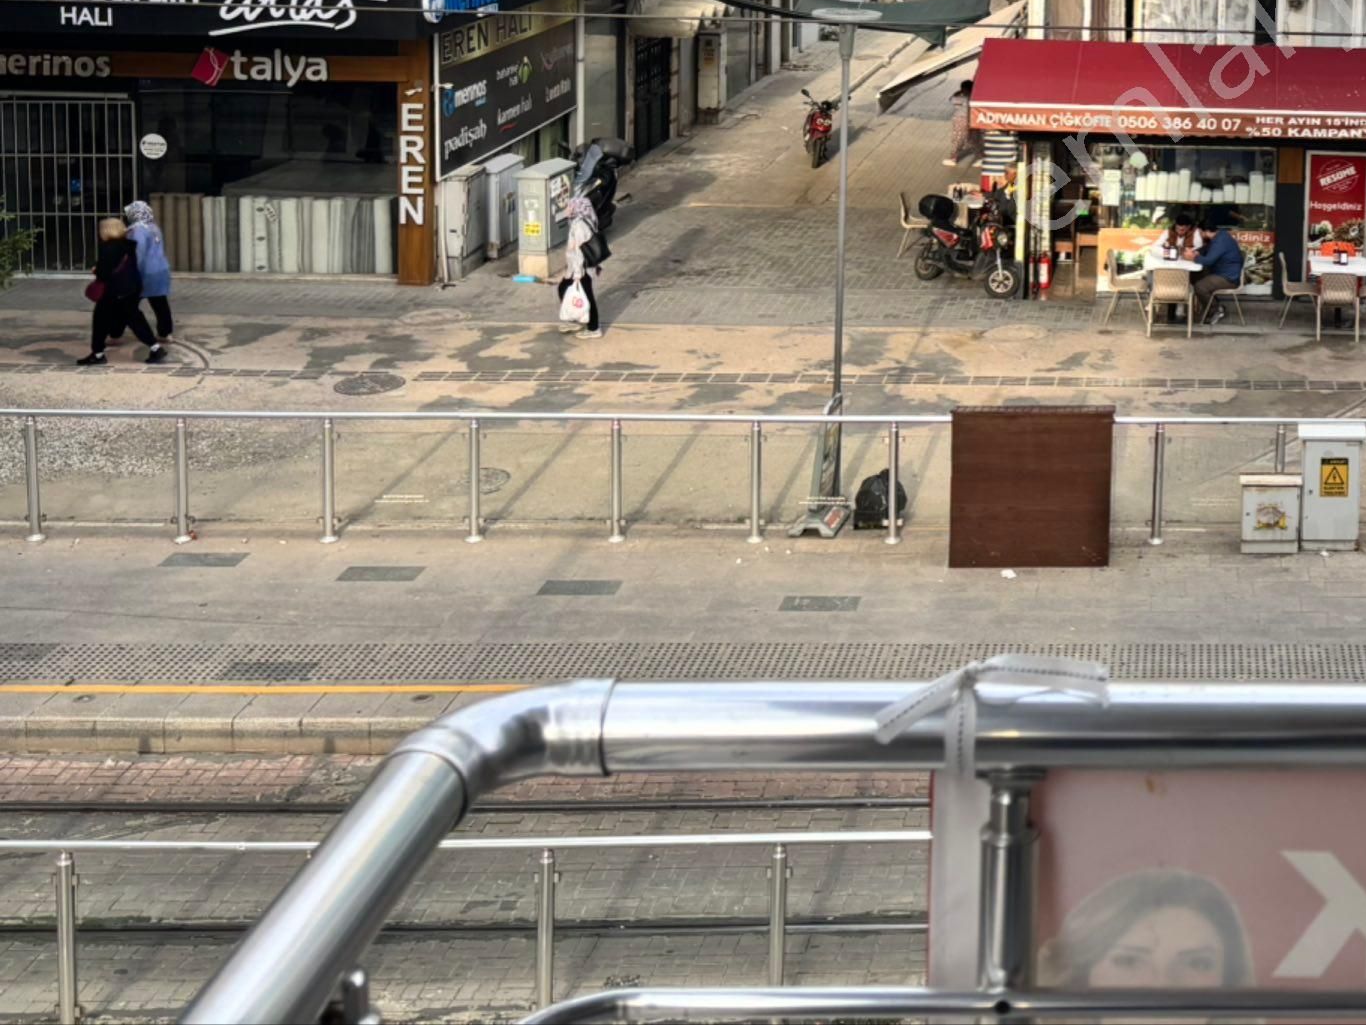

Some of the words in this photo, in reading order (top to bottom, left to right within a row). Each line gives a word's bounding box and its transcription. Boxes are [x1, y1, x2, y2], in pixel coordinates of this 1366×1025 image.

[60, 6, 114, 26] HALI
[441, 21, 489, 65] EREN
[230, 48, 328, 88] talya
[976, 112, 1047, 126] ADIYAMAN
[1117, 116, 1158, 128] 0506
[1162, 116, 1193, 130] 386
[1197, 118, 1217, 130] 40
[1221, 118, 1241, 131] 07
[1255, 116, 1284, 125] HER
[1287, 117, 1321, 127] AYIN
[1245, 127, 1282, 137] %50
[399, 103, 426, 225] EREN
